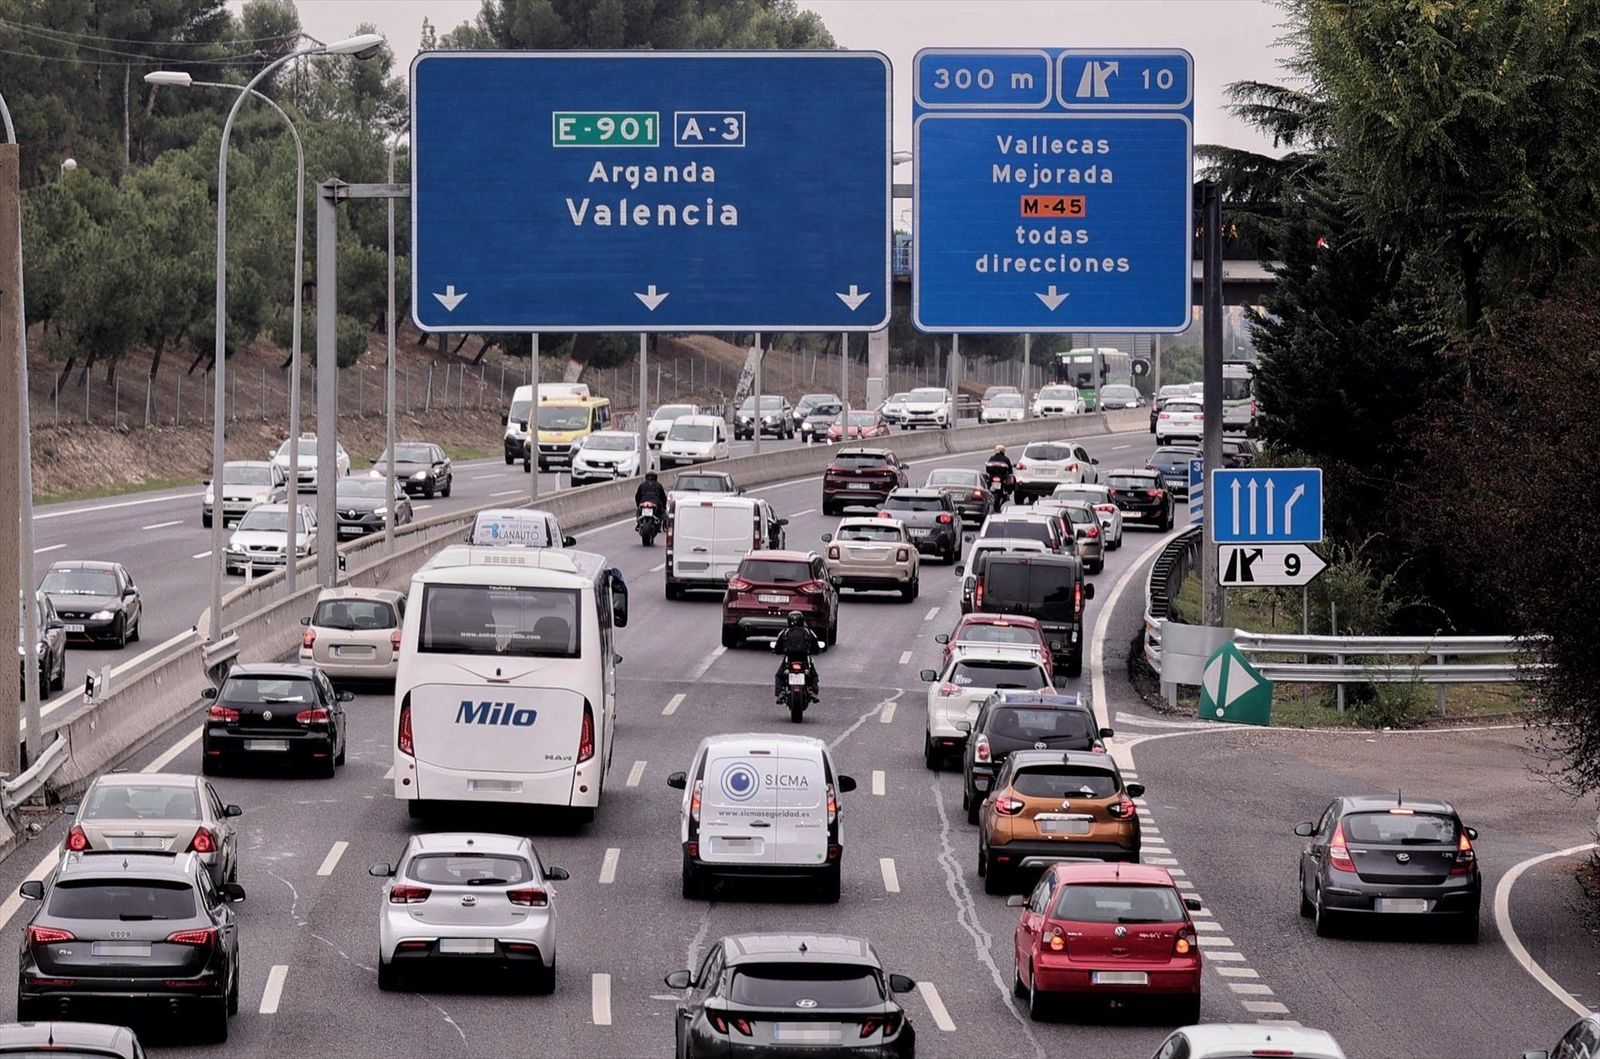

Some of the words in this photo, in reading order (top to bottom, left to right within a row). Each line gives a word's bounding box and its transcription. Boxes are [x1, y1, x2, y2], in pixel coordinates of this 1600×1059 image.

[933, 68, 995, 90] 300
[1011, 71, 1034, 89] m
[1141, 68, 1174, 90] 10
[558, 117, 656, 142] E-901
[681, 117, 740, 142] A-3
[996, 134, 1110, 155] Vallecas
[588, 160, 716, 190] Arganda
[992, 163, 1114, 189] Mejorada
[565, 197, 739, 227] Valencia
[1023, 198, 1083, 215] M-45
[1015, 225, 1089, 245] todas
[975, 253, 1130, 273] direcciones
[1283, 553, 1301, 577] 9
[455, 700, 538, 728] Milo
[764, 773, 809, 788] SICMA
[718, 810, 811, 819] www.sicmaseguridad.es
